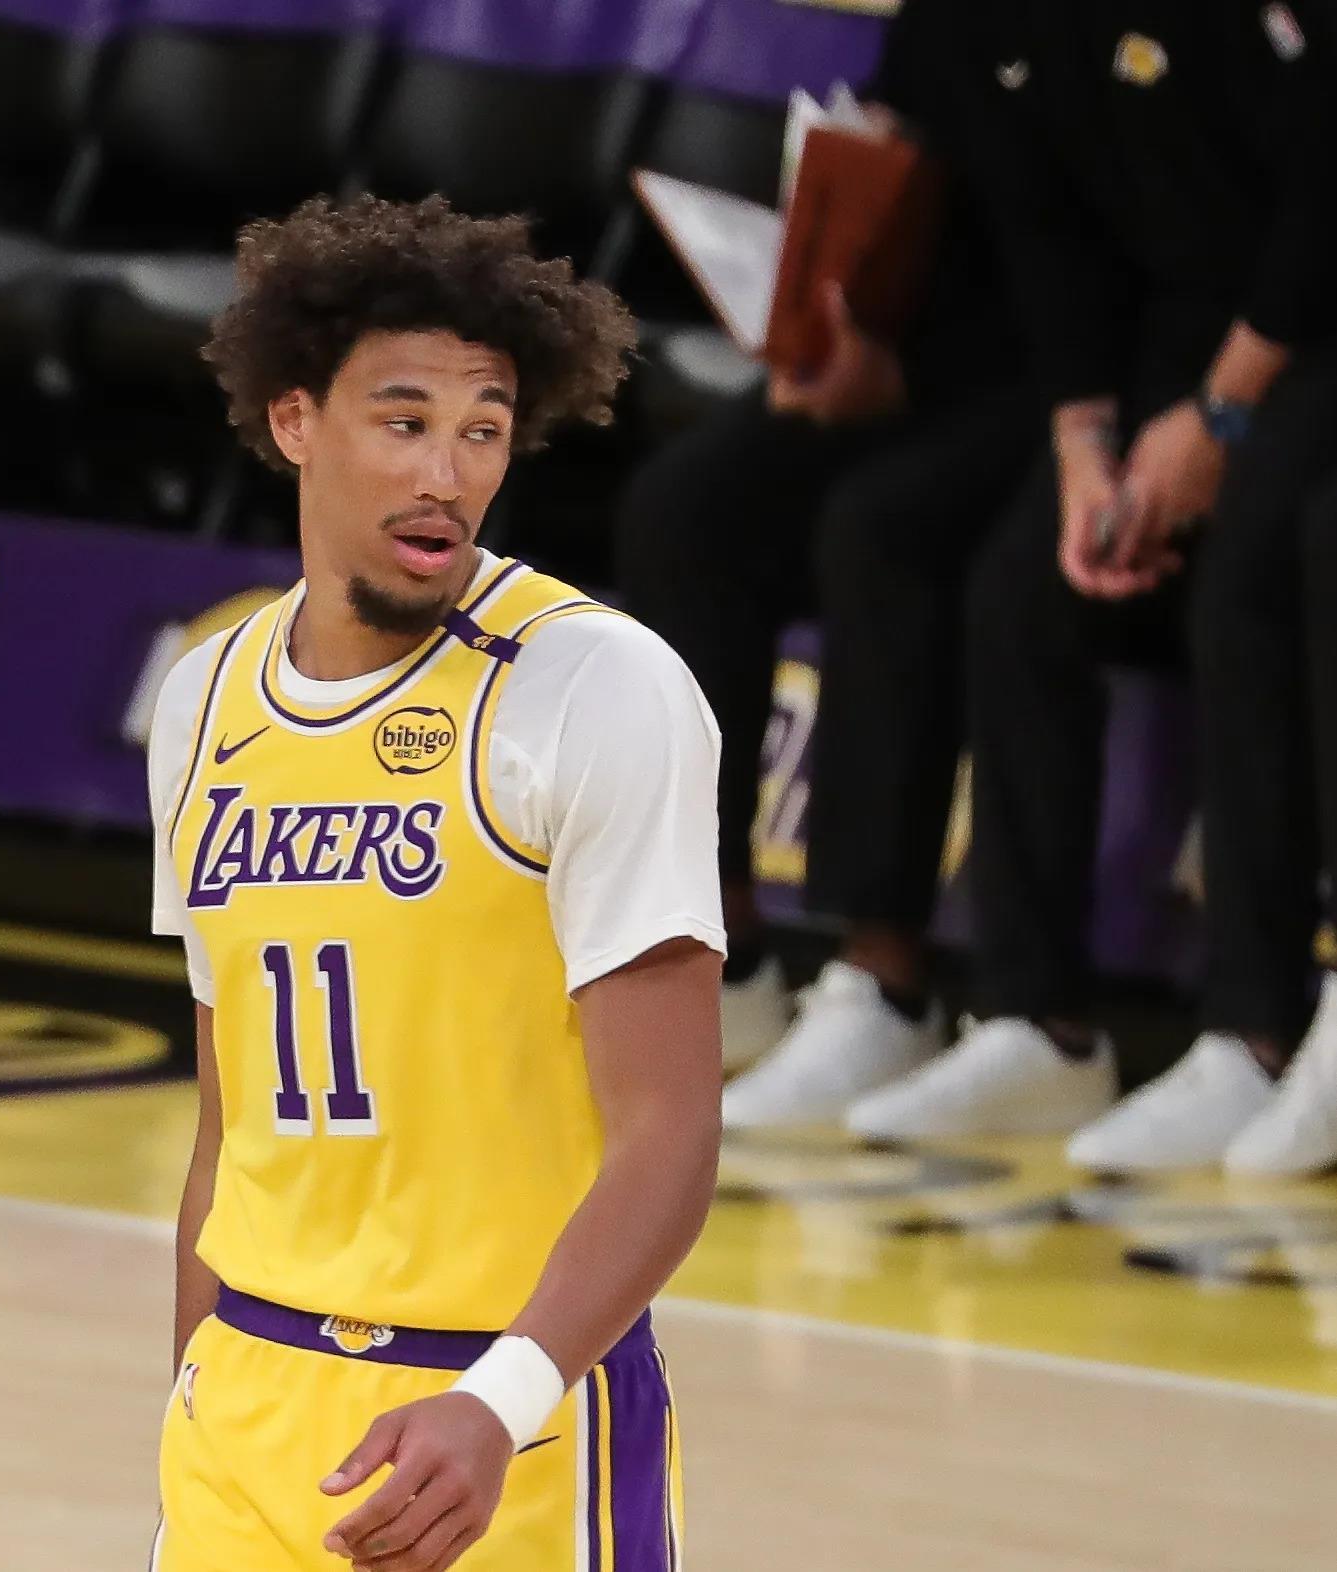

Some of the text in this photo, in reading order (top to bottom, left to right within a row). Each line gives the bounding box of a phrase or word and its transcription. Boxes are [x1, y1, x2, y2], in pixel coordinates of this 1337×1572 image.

[383, 725, 451, 754] bibigo
[186, 784, 447, 911] LAKERS
[262, 939, 377, 1136] 11
